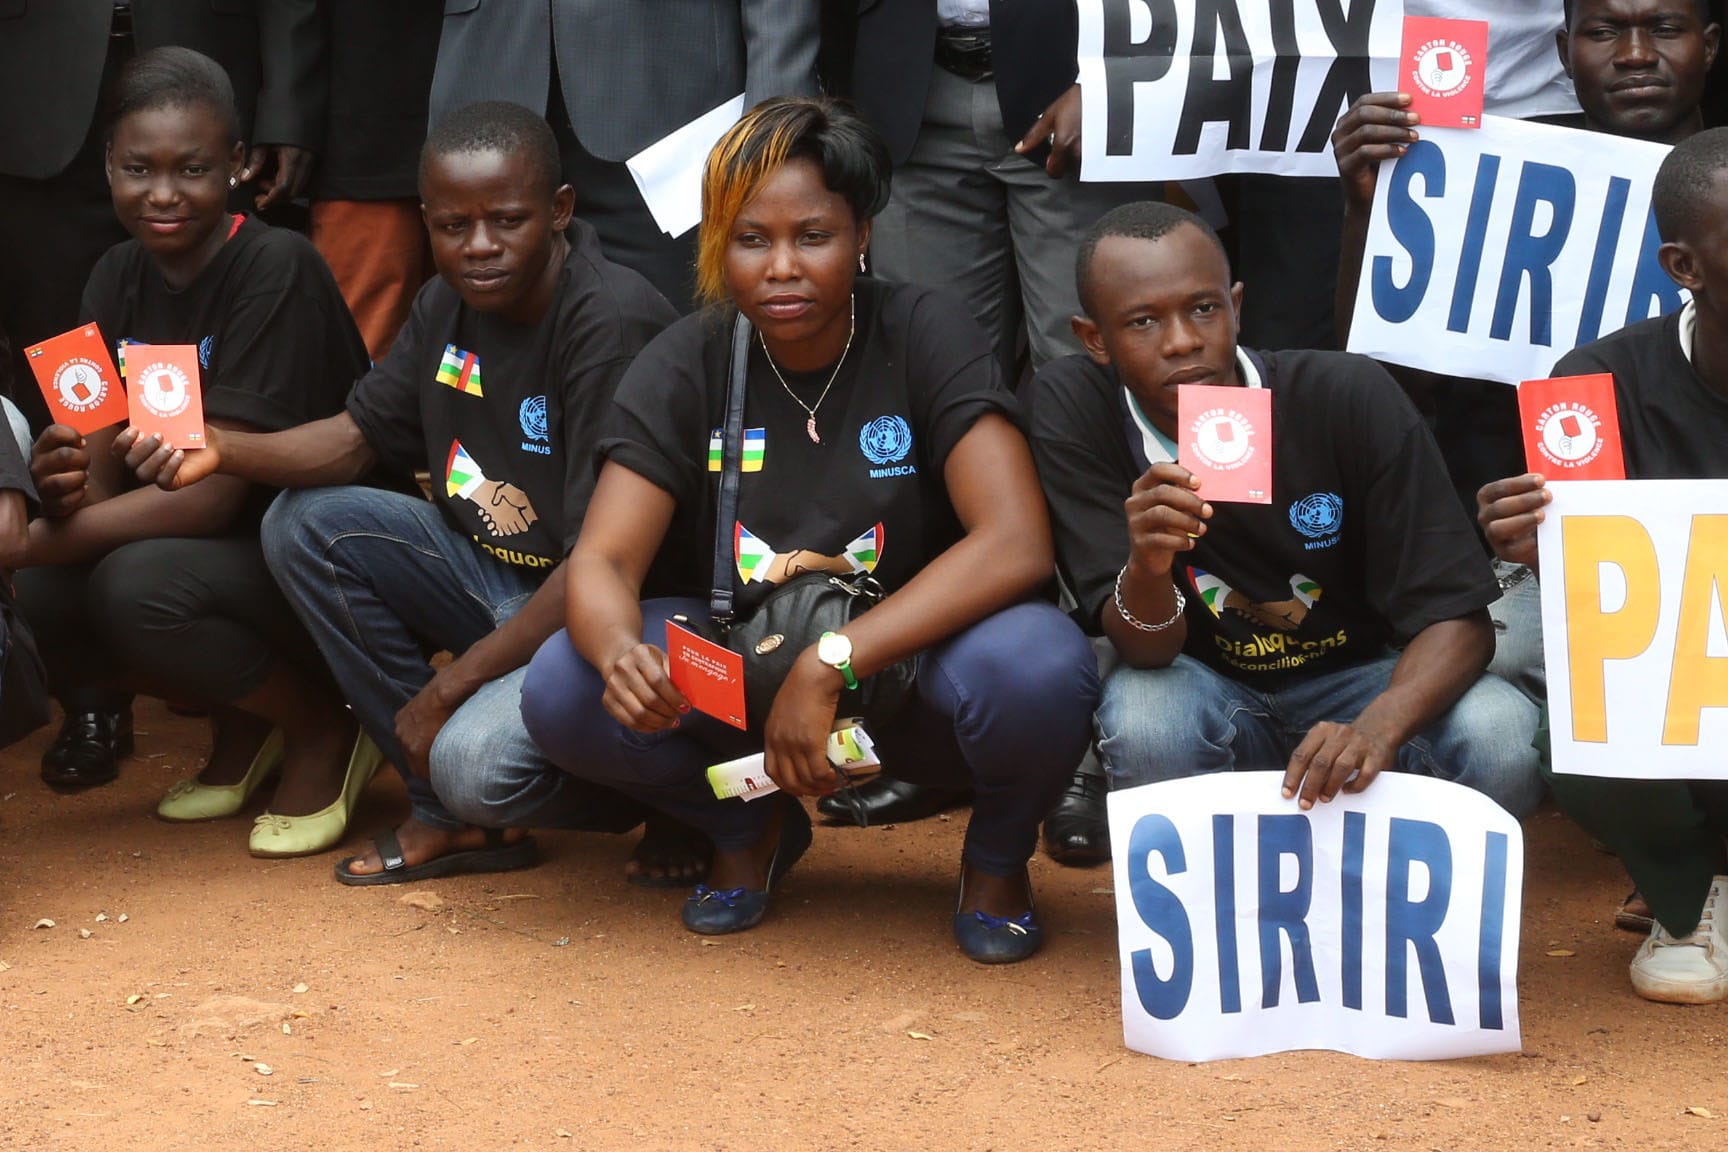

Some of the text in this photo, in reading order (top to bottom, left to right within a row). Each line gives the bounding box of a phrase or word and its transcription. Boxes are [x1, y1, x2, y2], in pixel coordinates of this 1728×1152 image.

[1412, 39, 1472, 65] CARTON ROUGE
[1411, 70, 1431, 94] CONTRE
[1442, 74, 1471, 97] VIOLENCE
[1371, 139, 1684, 347] SIRI
[88, 379, 107, 410] CARTON
[1535, 402, 1602, 431] CARTON ROUGE
[521, 441, 551, 455] MINUS
[1536, 440, 1563, 466] CONTRE
[1575, 437, 1604, 467] VIOLENCE
[869, 465, 917, 479] MINUSCA
[1304, 535, 1339, 550] MINUS
[1561, 513, 1728, 747] PA
[1127, 811, 1509, 1031] SIRIRI
